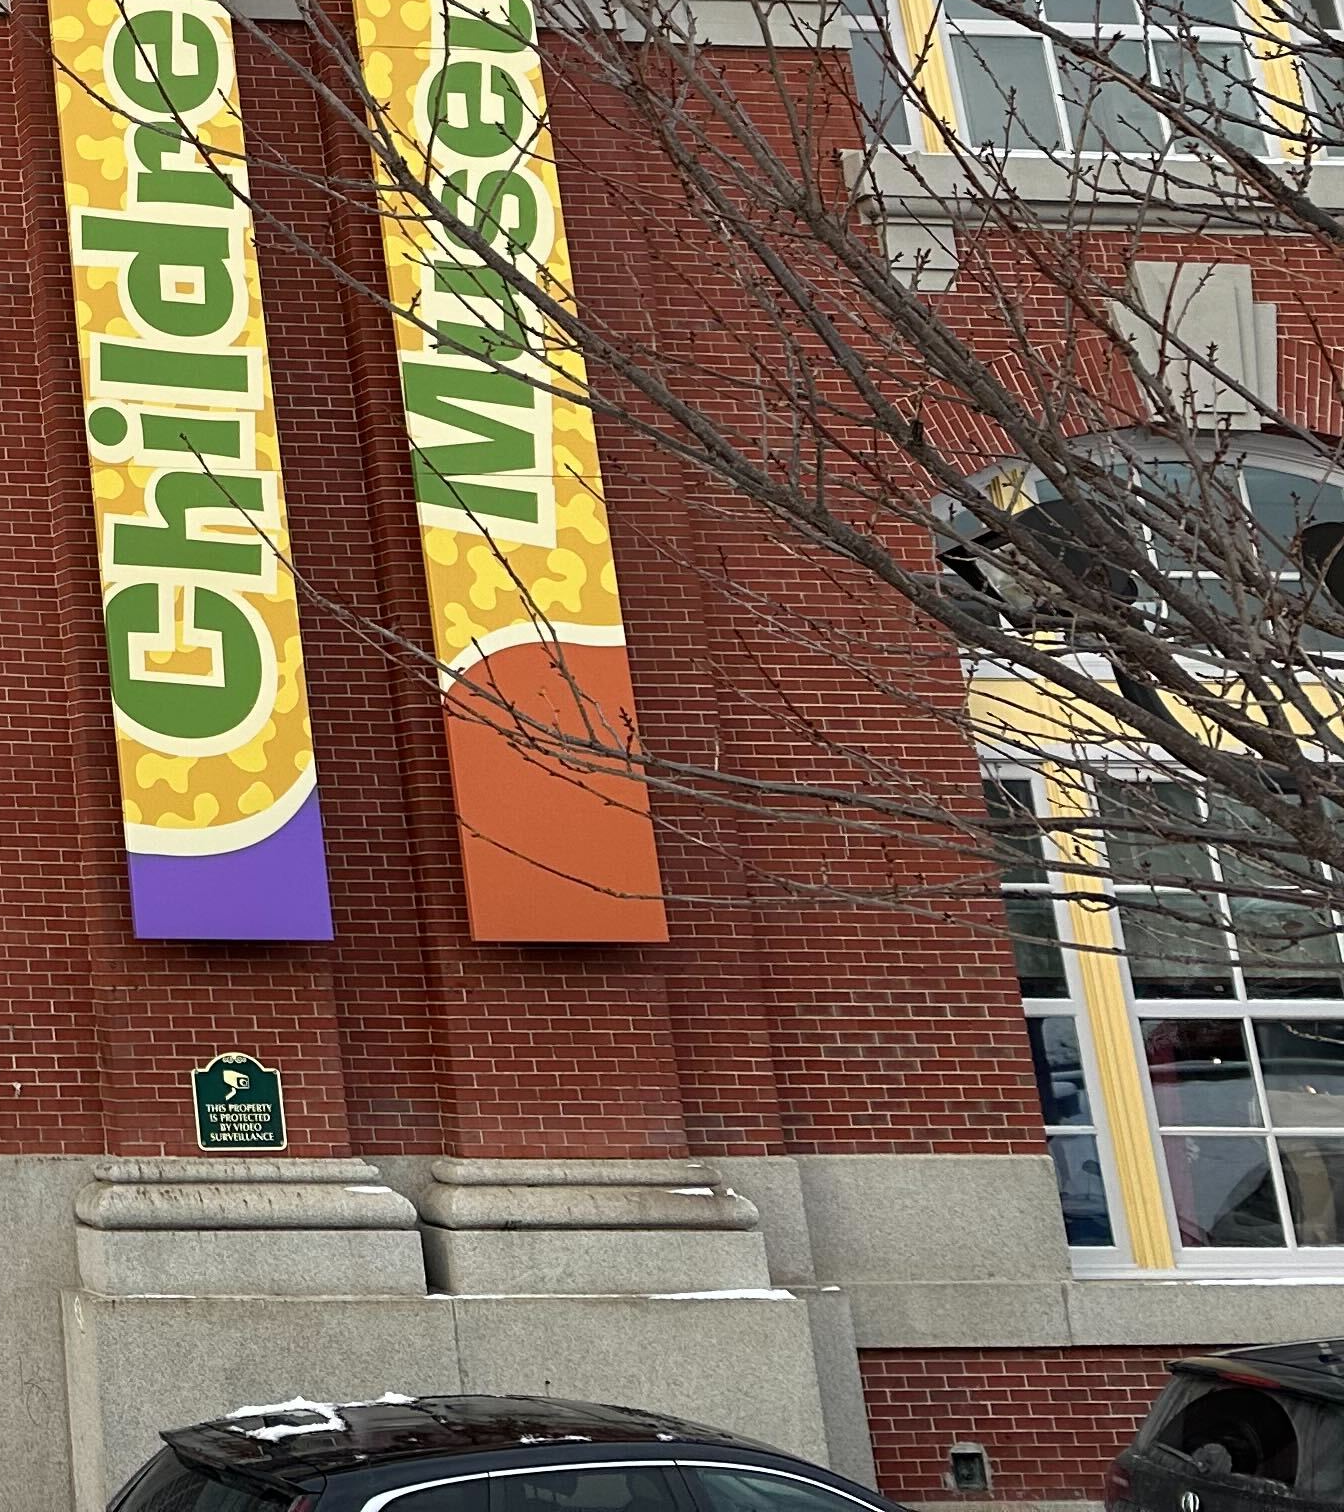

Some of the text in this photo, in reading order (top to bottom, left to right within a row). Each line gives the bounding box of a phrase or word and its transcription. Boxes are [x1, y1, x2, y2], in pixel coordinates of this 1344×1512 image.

[205, 1103, 272, 1113] THIS PROPERTY
[209, 1113, 271, 1123] IS PROTECTED
[220, 1123, 263, 1132] BY VIDEO
[210, 1132, 275, 1142] SURVEILLANCE
